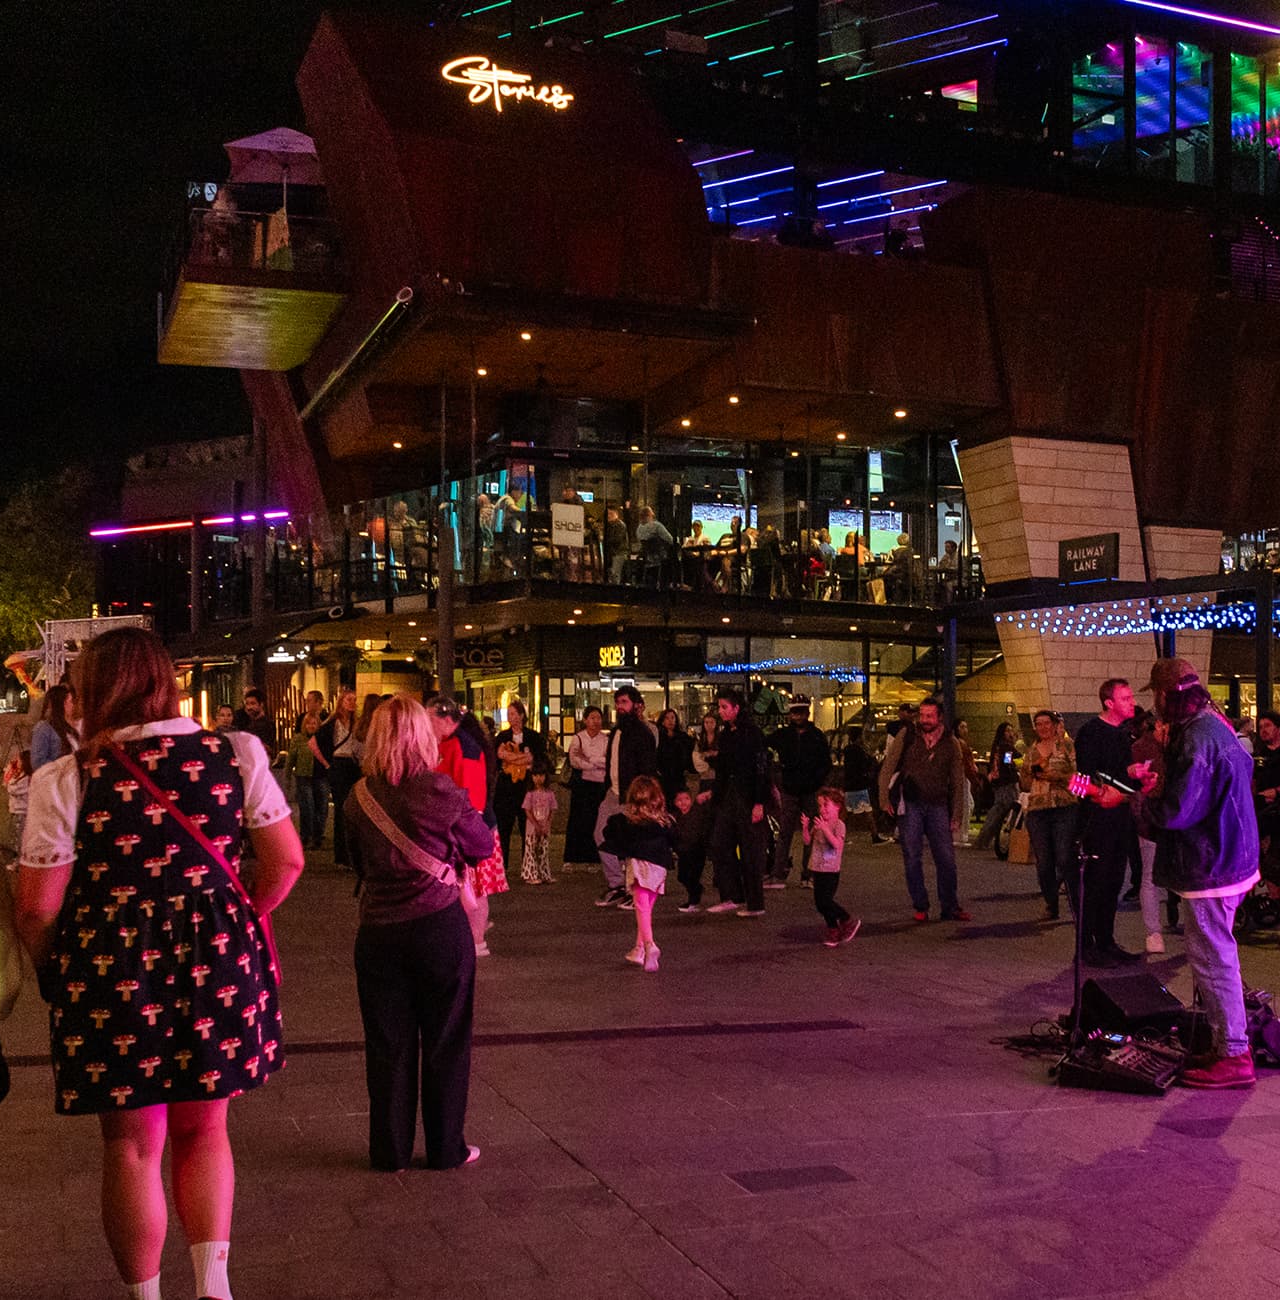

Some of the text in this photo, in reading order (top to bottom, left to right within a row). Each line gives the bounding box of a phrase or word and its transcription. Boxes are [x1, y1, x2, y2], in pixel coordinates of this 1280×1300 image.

[442, 56, 574, 113] Stories
[1066, 545, 1105, 561] RAILWAY
[1073, 559, 1097, 572] LANE
